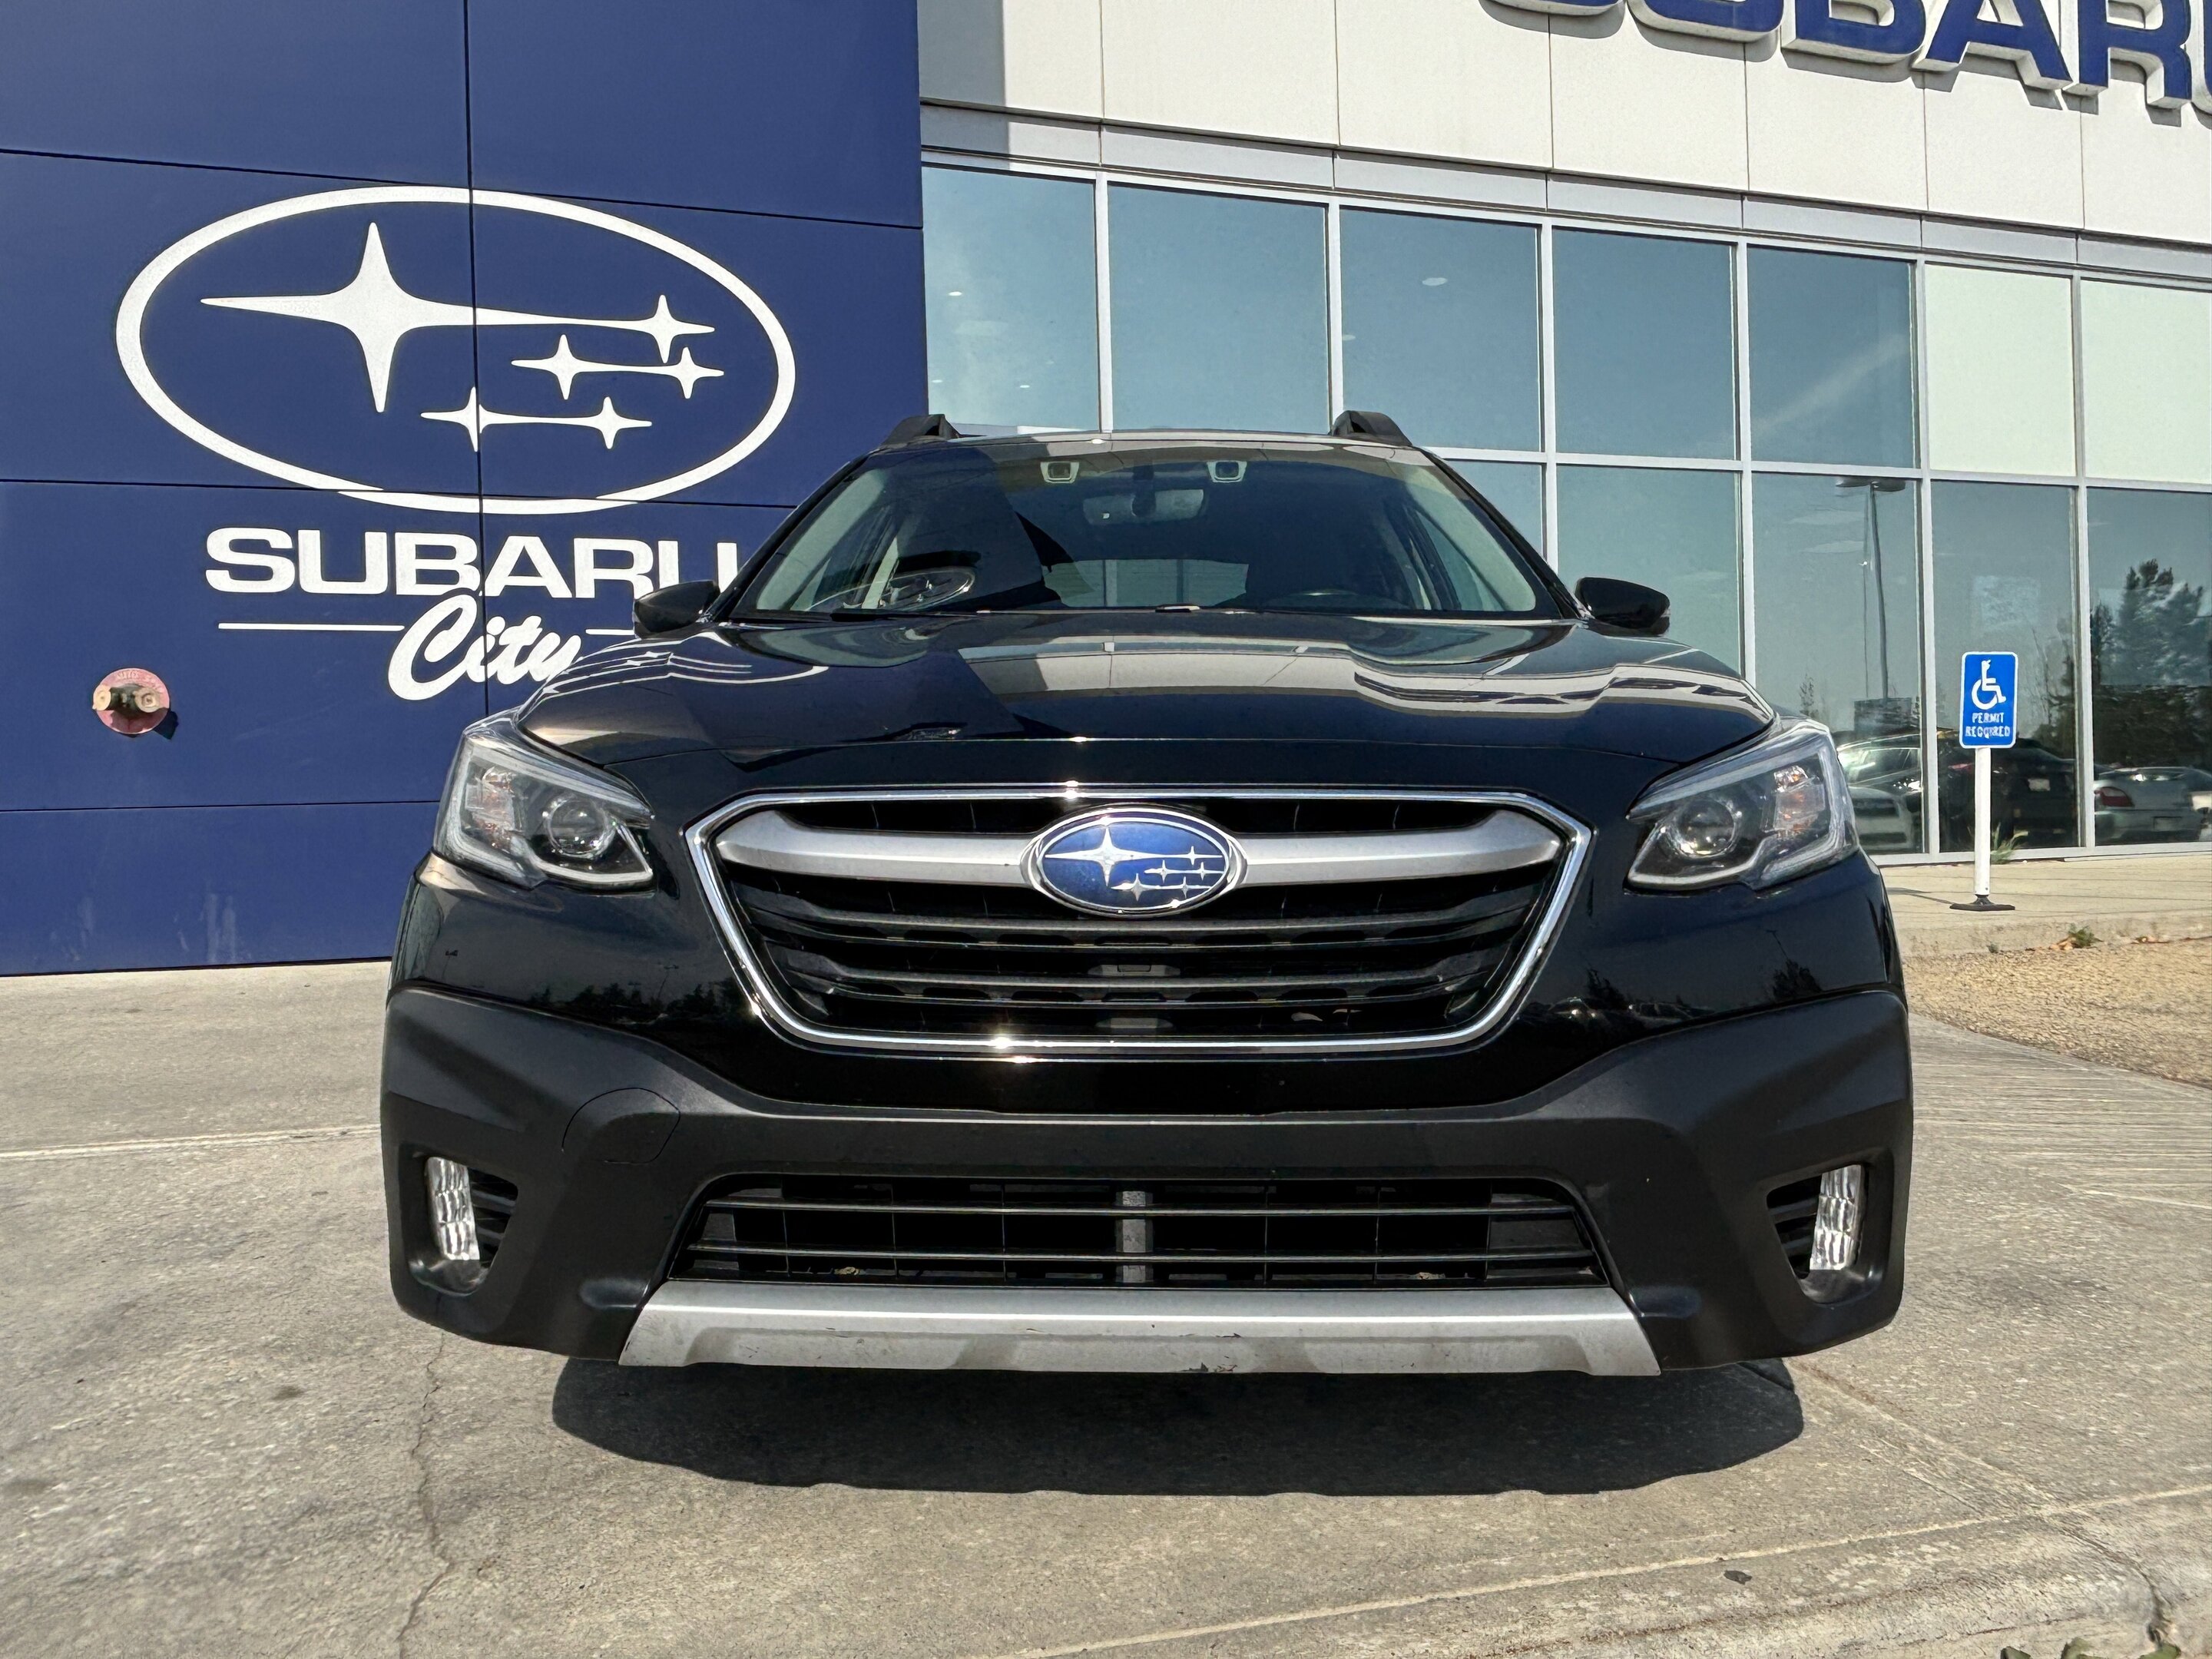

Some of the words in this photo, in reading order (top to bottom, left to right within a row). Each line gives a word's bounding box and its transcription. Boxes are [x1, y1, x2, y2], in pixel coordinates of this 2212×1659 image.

[388, 594, 581, 700] City
[1972, 712, 2005, 724] PERMIT
[1965, 725, 2011, 739] REQUIRED
